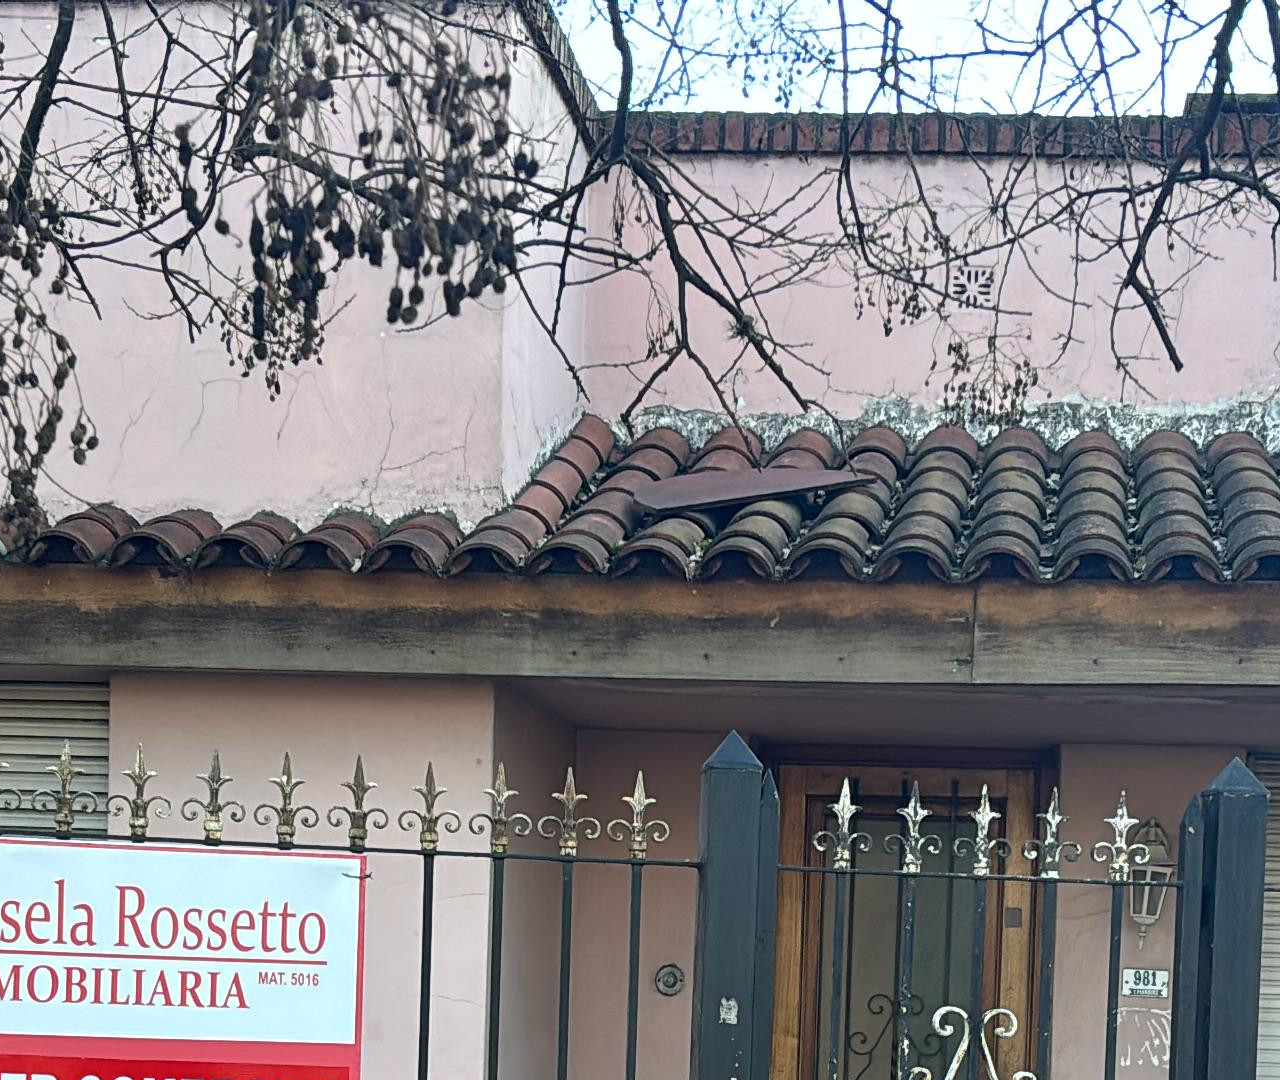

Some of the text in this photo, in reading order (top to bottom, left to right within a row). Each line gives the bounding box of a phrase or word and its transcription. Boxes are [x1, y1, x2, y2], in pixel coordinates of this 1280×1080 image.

[114, 885, 328, 955] Rossetto
[257, 971, 320, 988] MAT. 5016
[1133, 970, 1157, 986] 981
